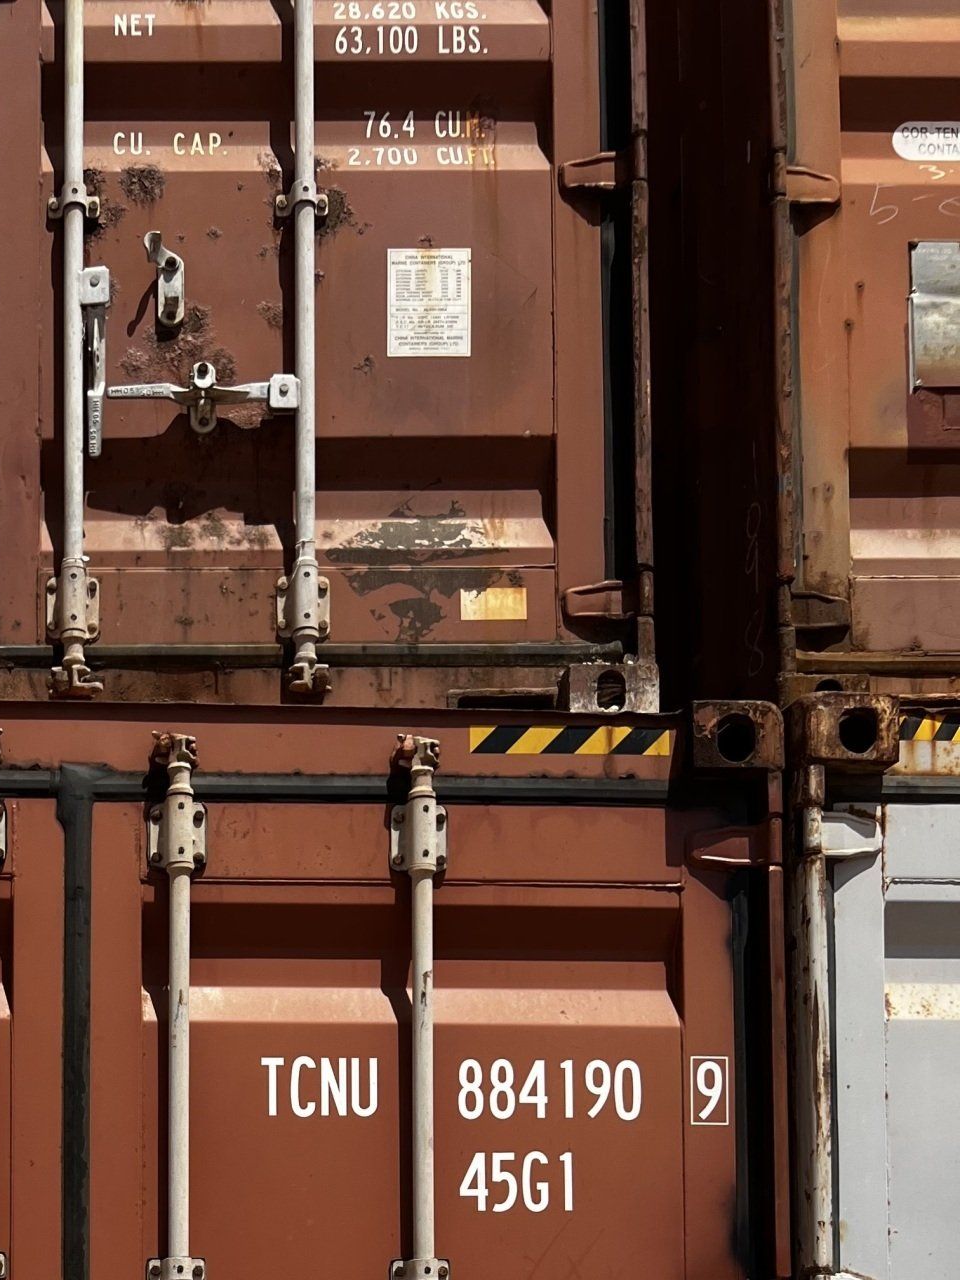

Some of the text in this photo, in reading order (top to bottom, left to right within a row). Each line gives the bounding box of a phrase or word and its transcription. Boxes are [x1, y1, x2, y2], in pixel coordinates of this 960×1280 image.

[333, 1, 487, 20] 28,620 KGS.
[114, 14, 156, 37] NET
[335, 25, 488, 54] 63,100 LBS.
[363, 110, 415, 139] 76.4
[901, 127, 959, 139] COR-TEN
[113, 132, 229, 156] CU. CAP.
[348, 147, 418, 166] 2,700
[261, 1056, 724, 1121] TCNU 884190 9
[459, 1150, 574, 1212] 45G1
